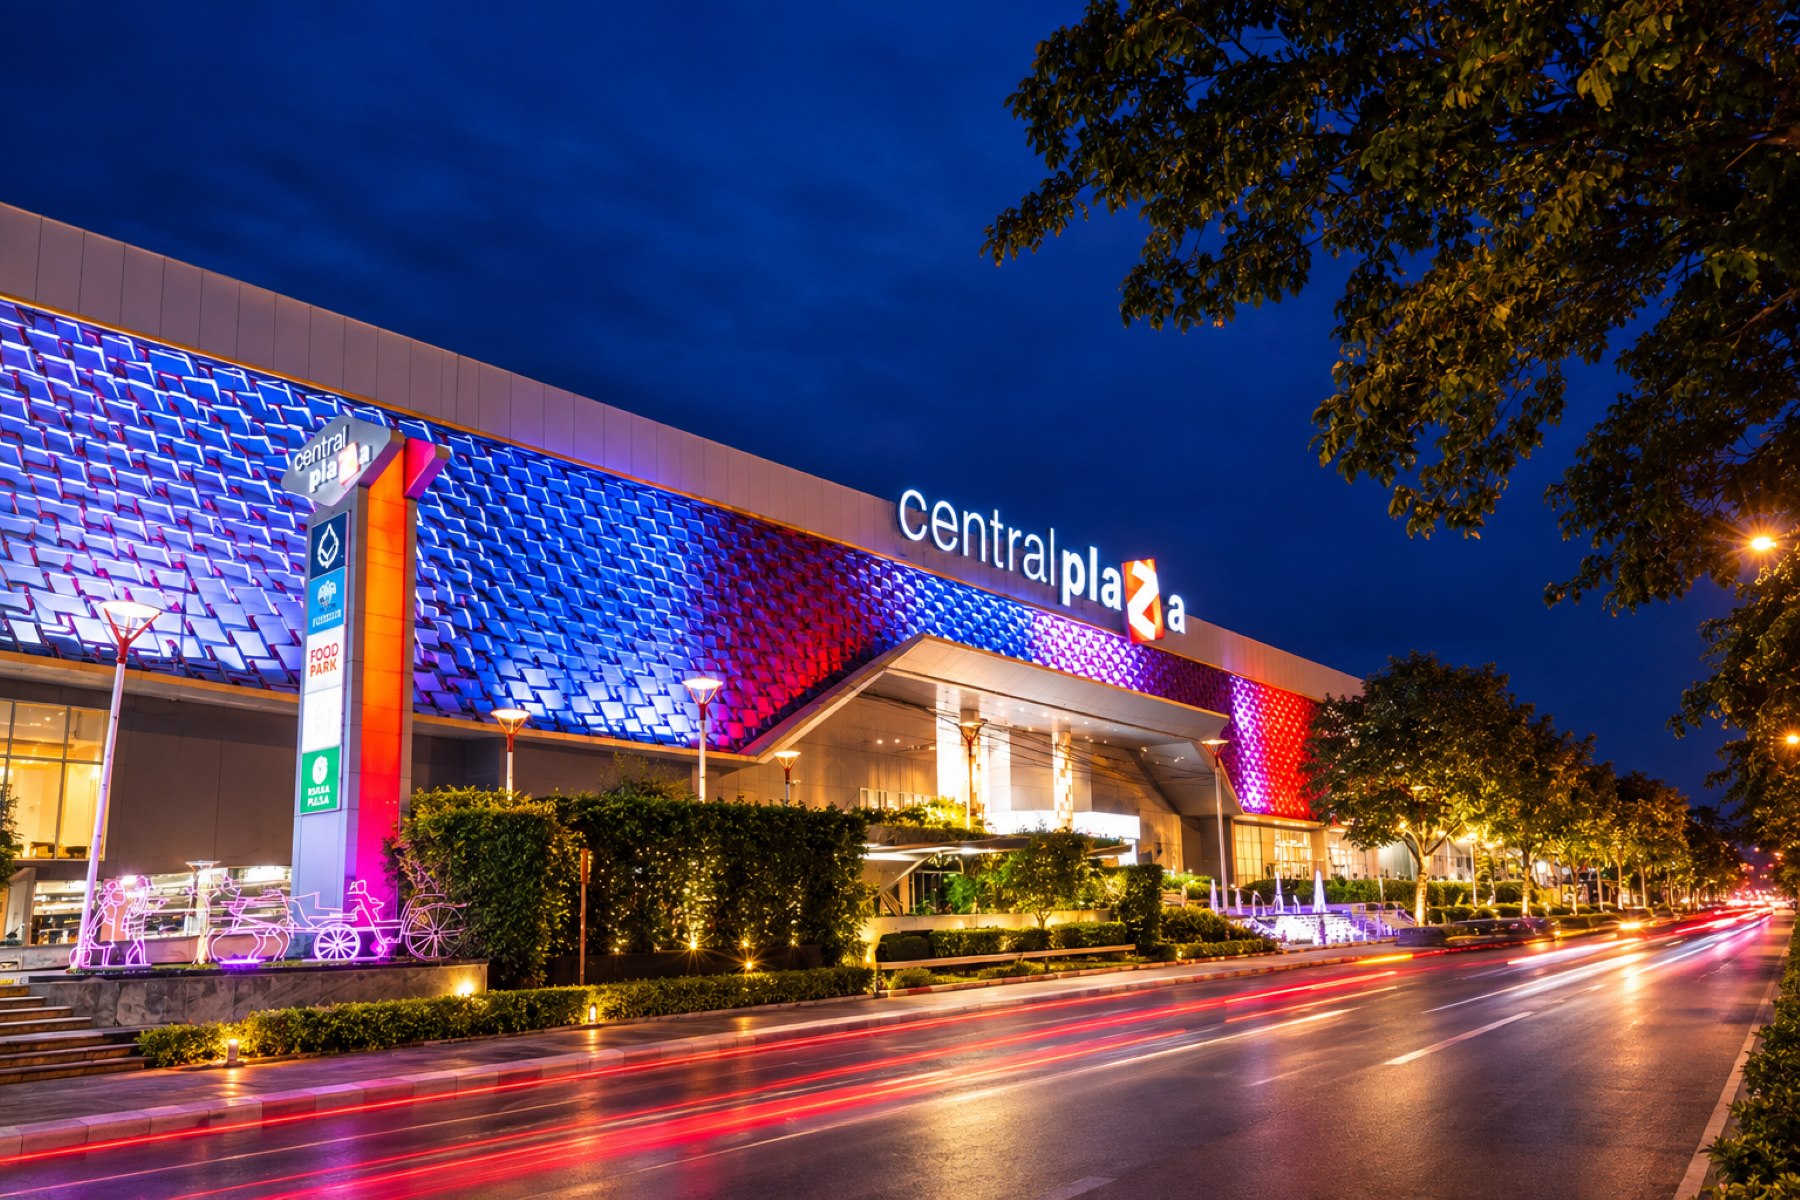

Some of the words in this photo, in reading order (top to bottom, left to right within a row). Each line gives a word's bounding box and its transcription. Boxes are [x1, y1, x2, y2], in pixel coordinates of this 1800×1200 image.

[294, 425, 347, 471] central
[310, 642, 339, 663] FOOD
[310, 658, 337, 677] PARK
